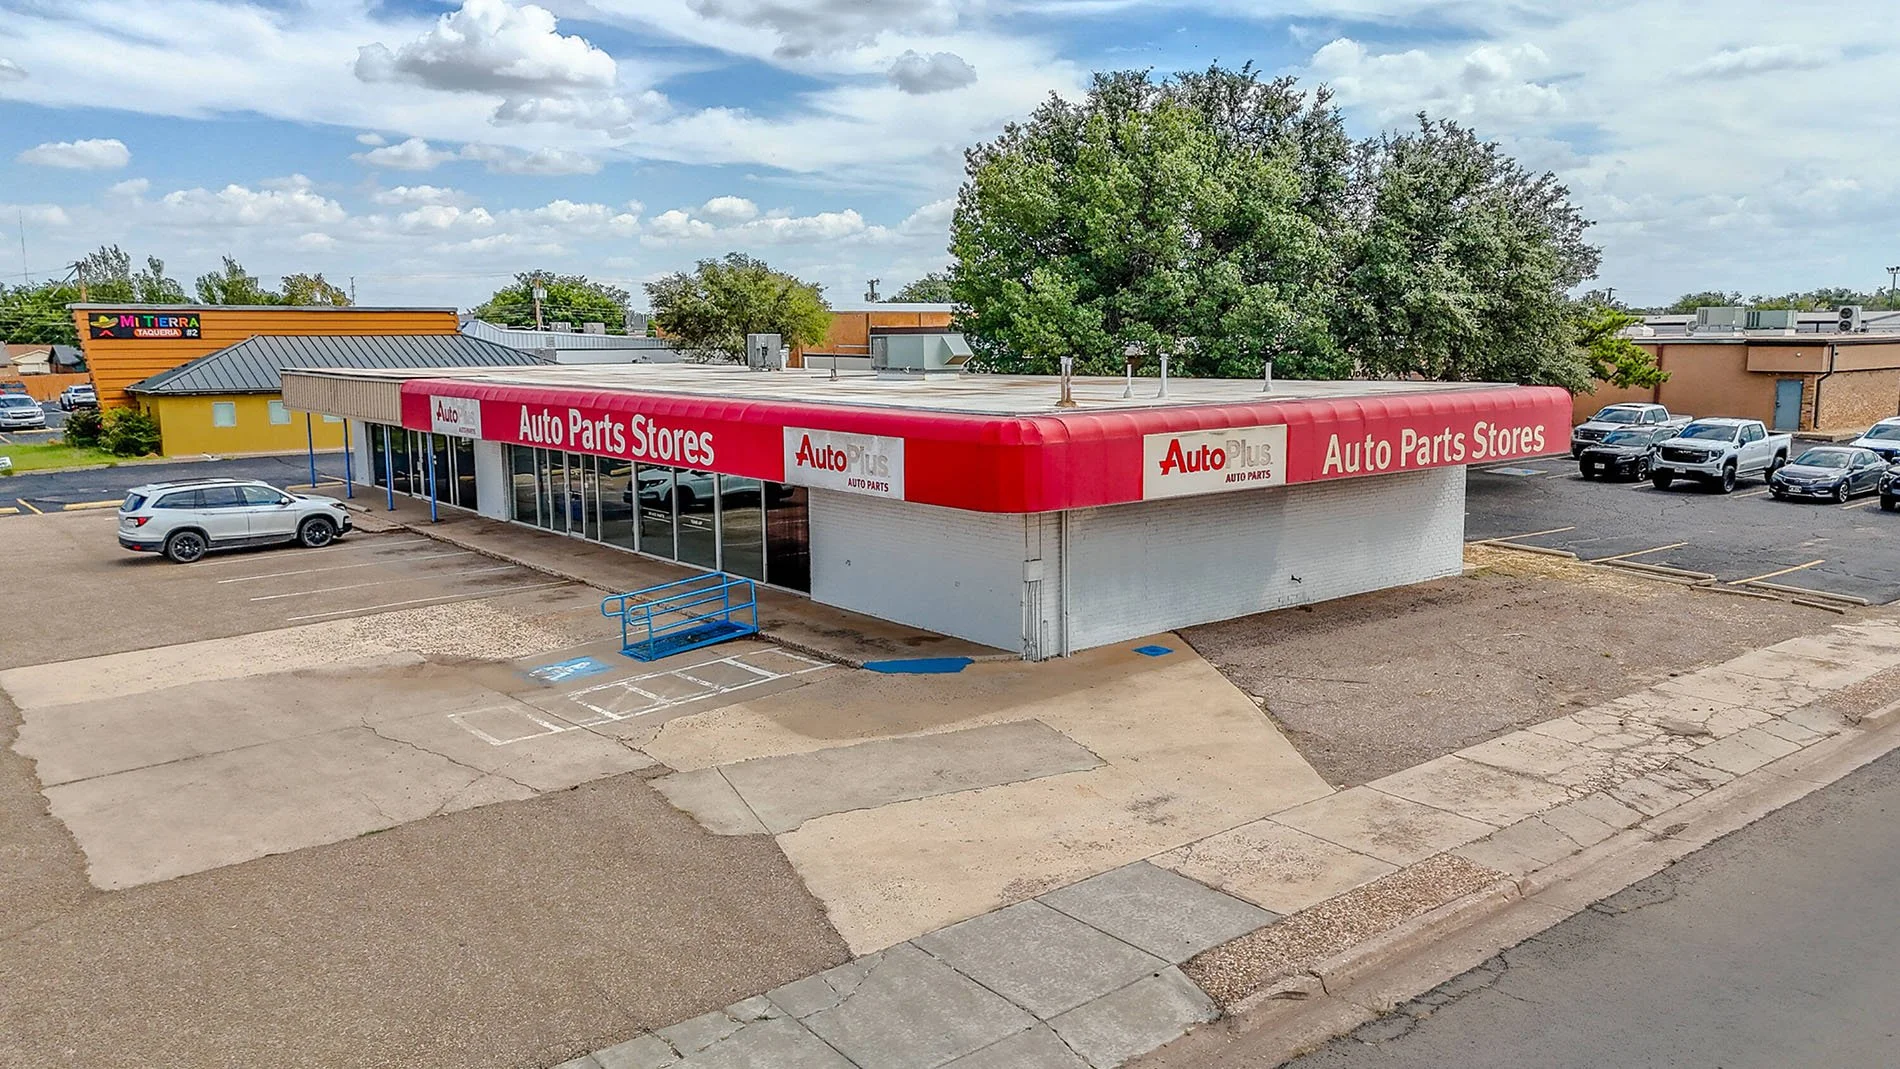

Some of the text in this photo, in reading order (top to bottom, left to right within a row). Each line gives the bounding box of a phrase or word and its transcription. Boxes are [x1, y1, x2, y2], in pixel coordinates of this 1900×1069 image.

[143, 315, 199, 328] TIERRA
[138, 329, 198, 337] TAQUERIA #2
[519, 405, 714, 466] Auto Parts Stores
[1322, 421, 1545, 475] Auto Parts Stores
[1225, 469, 1271, 483] AUTO PARTS
[848, 478, 889, 492] AUTO PARTS
